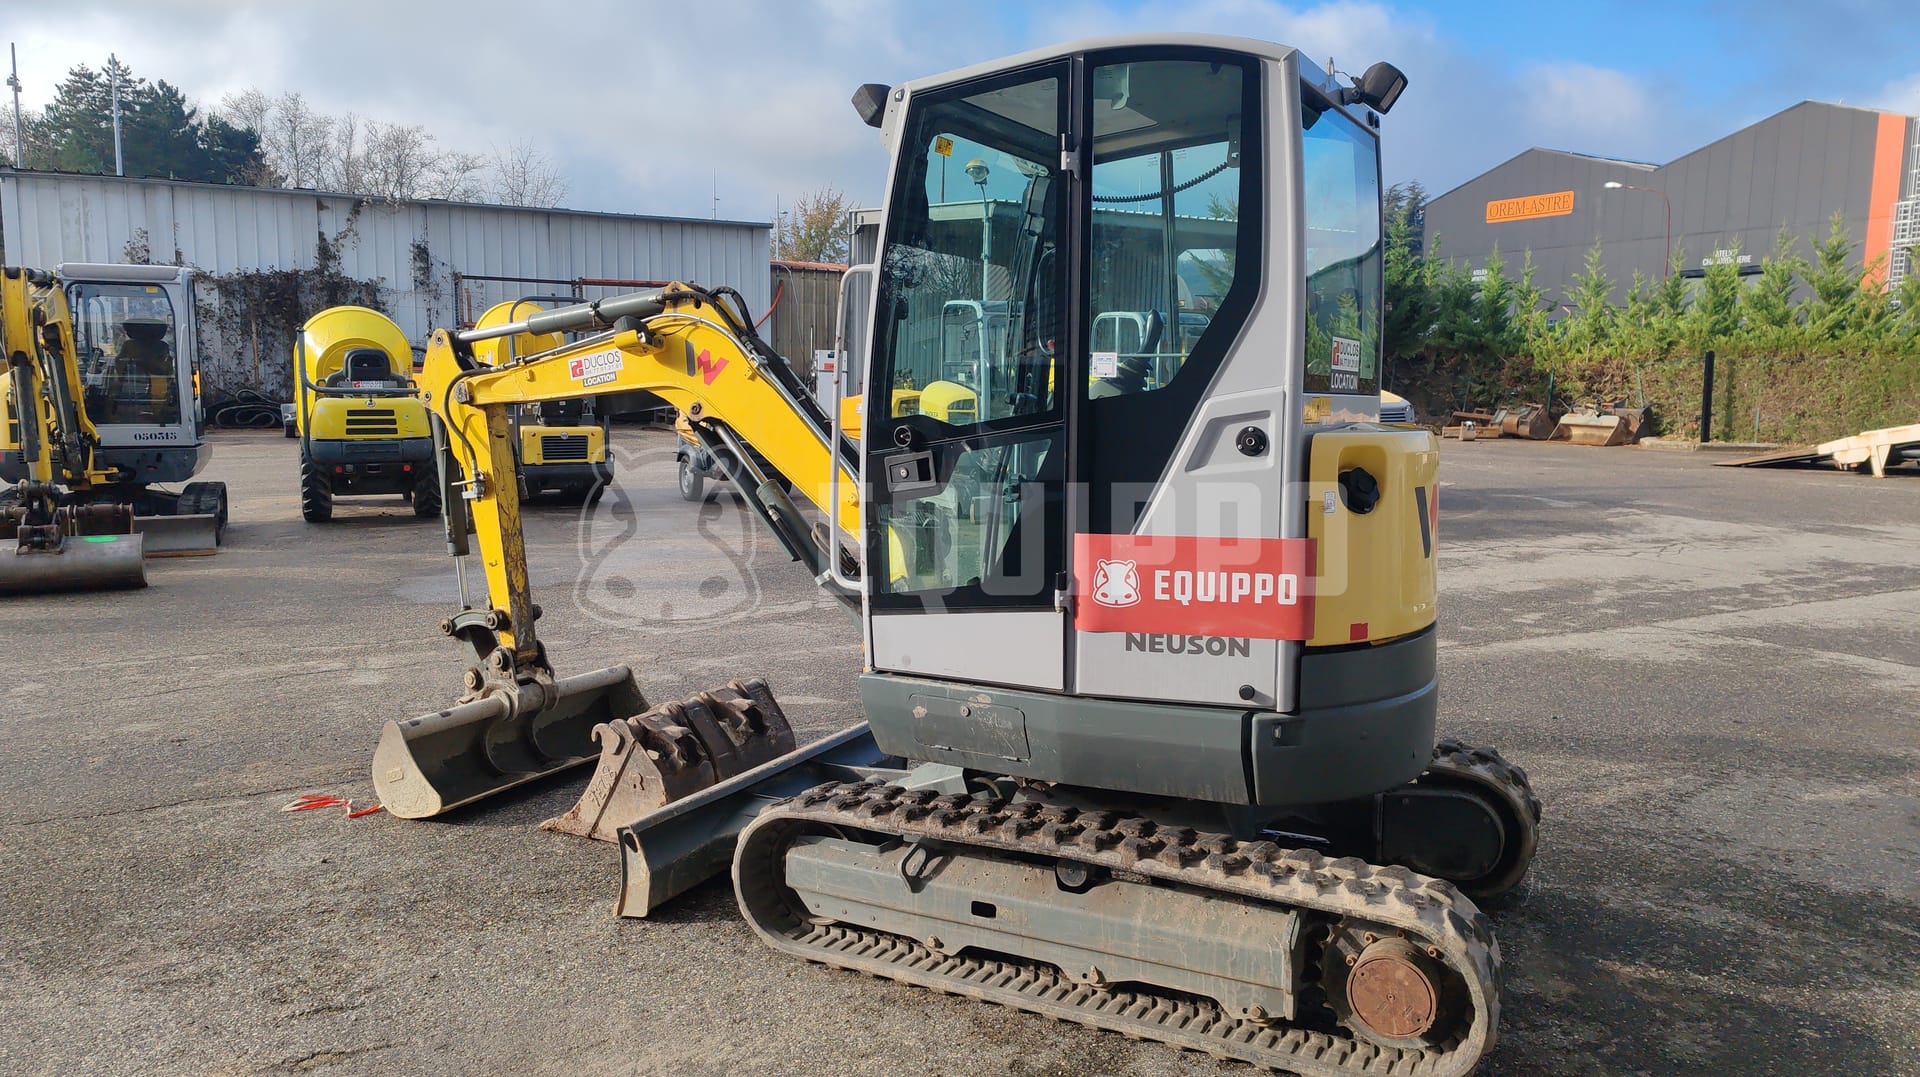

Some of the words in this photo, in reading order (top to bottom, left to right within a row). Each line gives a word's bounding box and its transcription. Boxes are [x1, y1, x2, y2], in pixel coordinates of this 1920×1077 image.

[1489, 194, 1571, 217] OREM-ASTRE
[583, 350, 621, 369] DUCLOS
[584, 373, 616, 386] LOCATION
[1125, 632, 1250, 657] NEUSON
